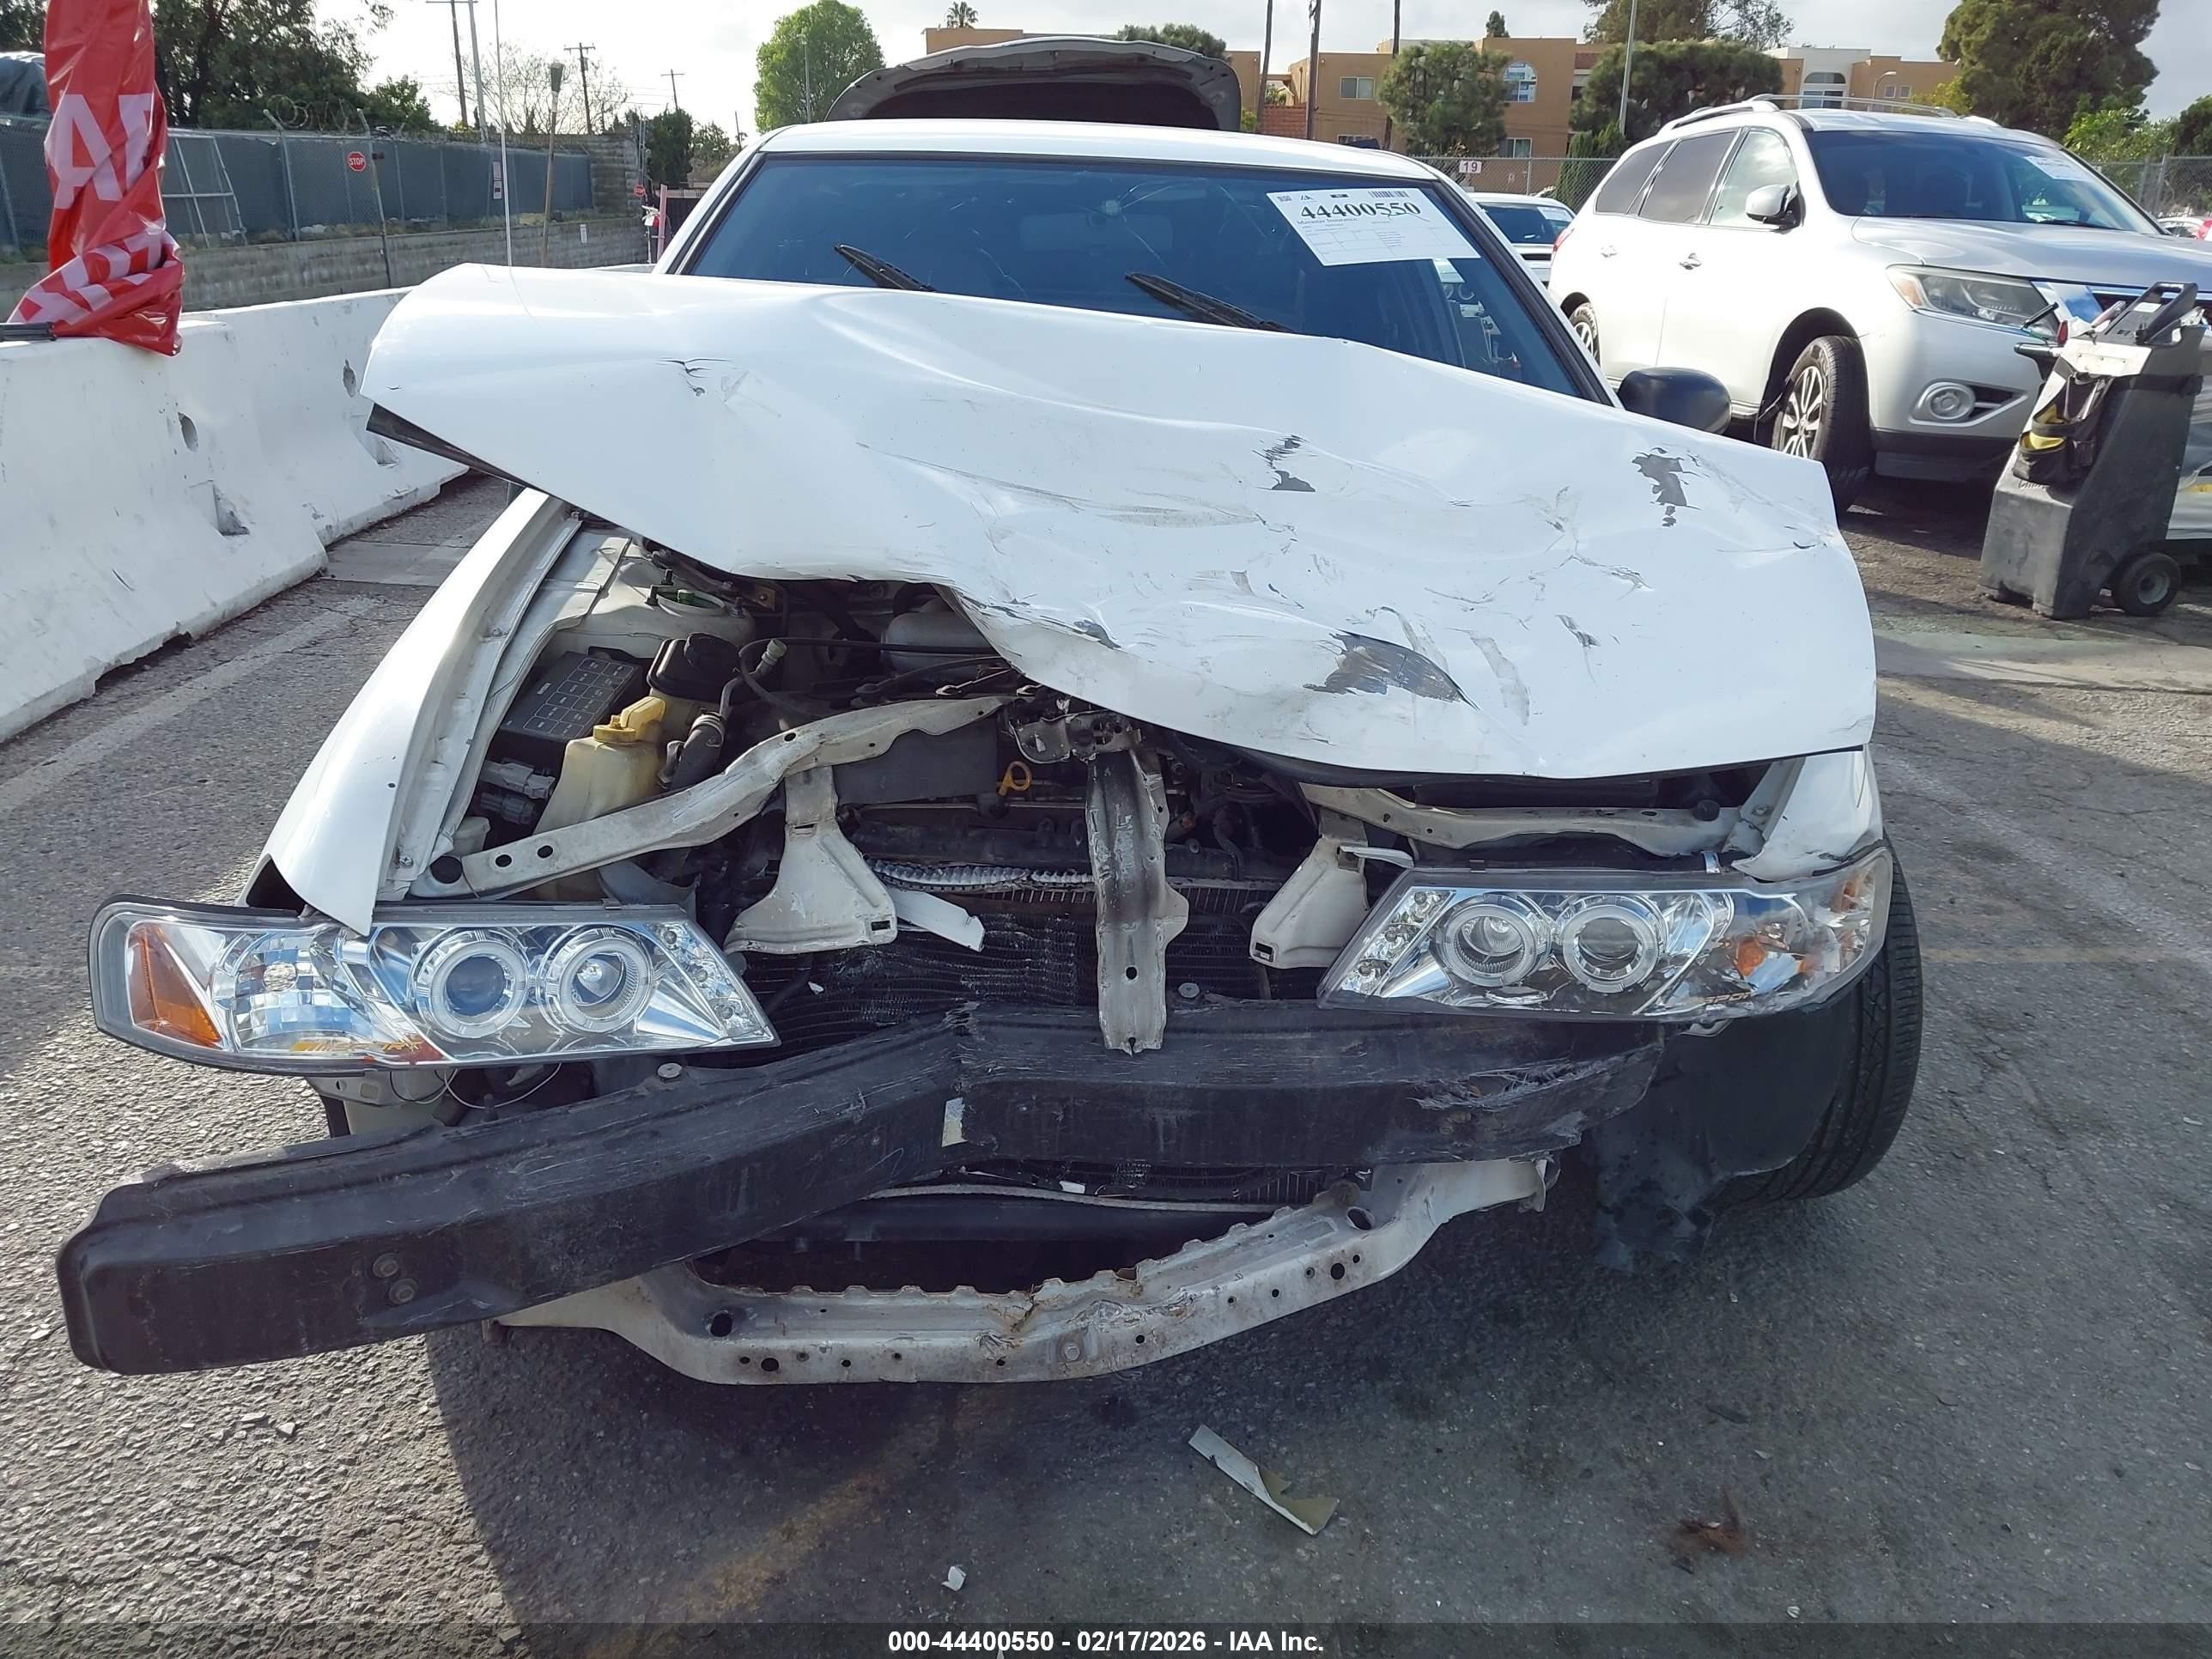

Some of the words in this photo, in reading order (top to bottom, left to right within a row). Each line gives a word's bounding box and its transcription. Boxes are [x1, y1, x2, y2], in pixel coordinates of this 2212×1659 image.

[349, 157, 364, 166] STOP
[1463, 161, 1478, 173] 19
[1301, 202, 1421, 219] 44400550
